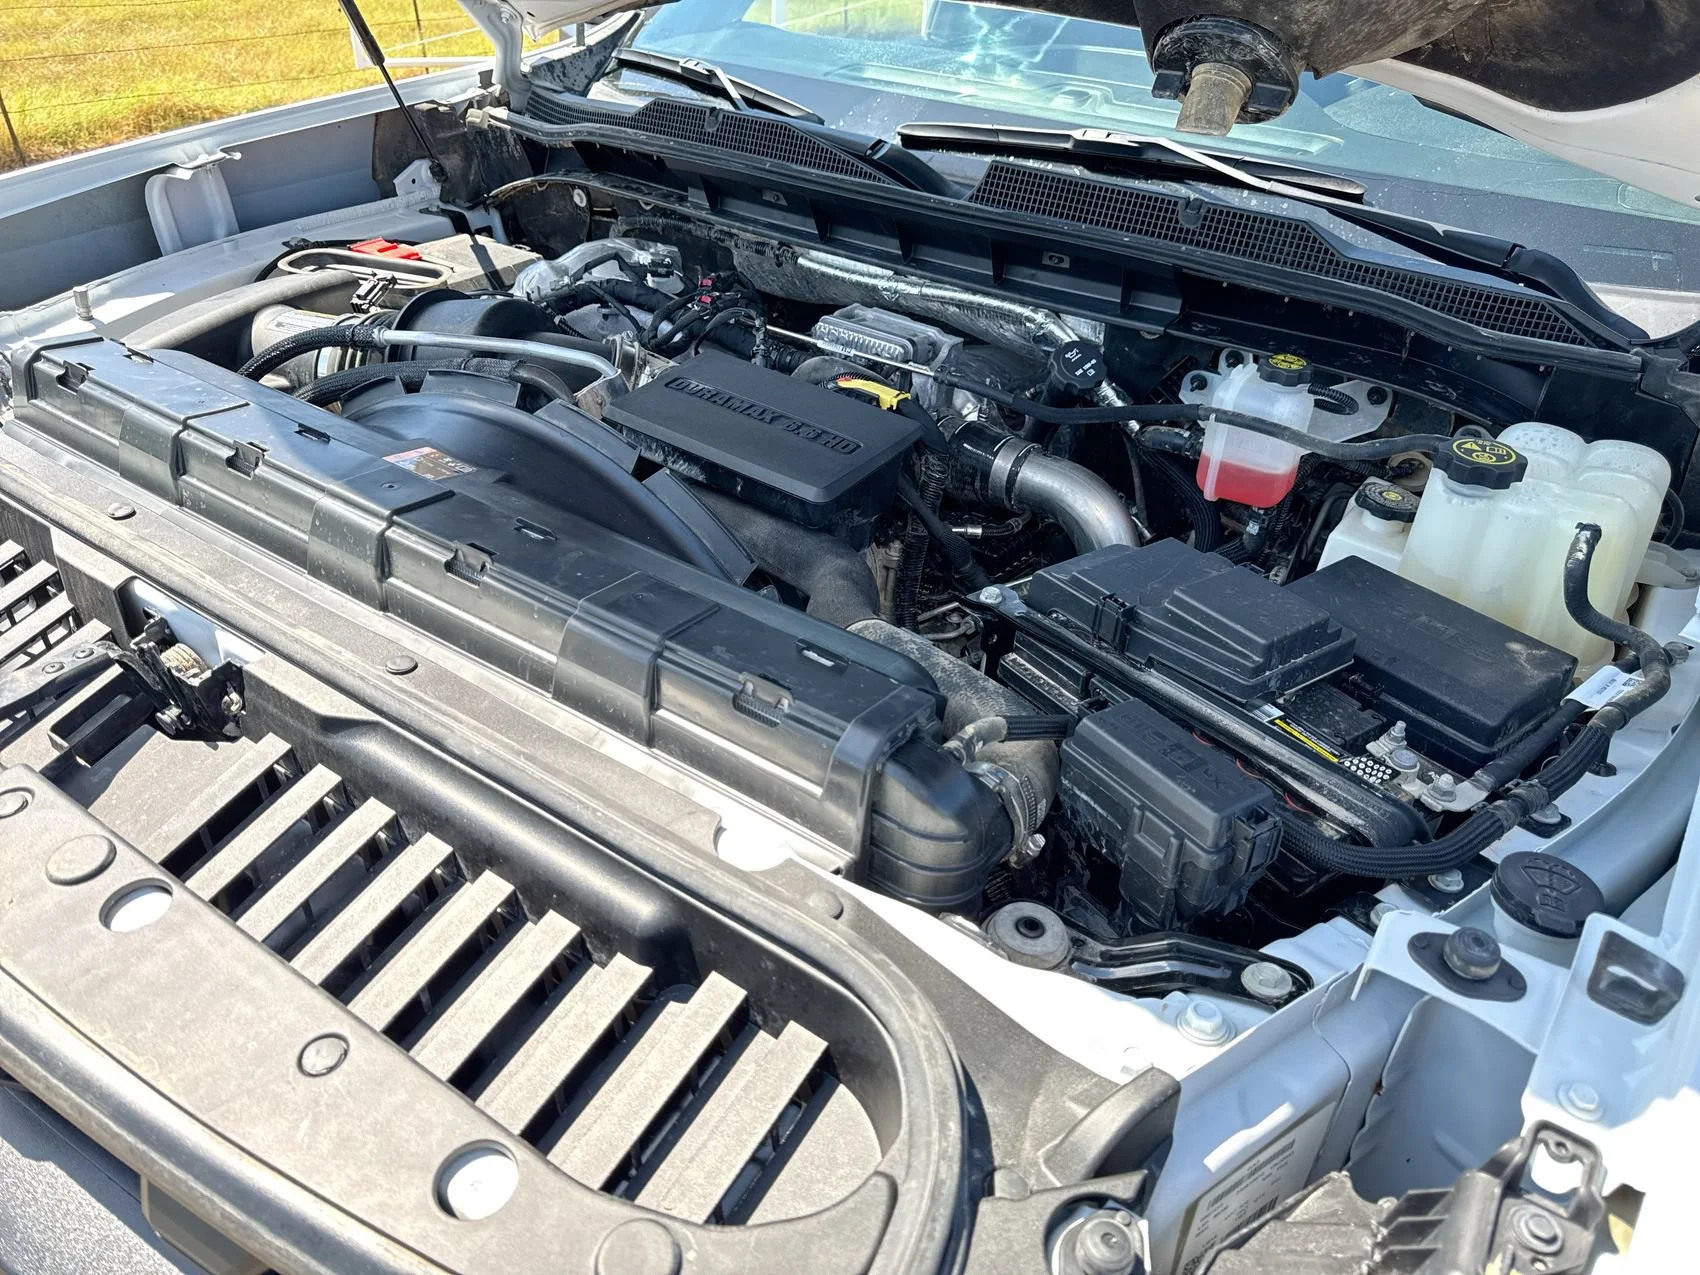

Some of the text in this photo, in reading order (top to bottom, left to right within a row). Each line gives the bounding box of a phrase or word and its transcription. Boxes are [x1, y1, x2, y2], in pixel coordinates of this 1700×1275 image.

[670, 378, 860, 454] DURAMAX 6.6 HD
